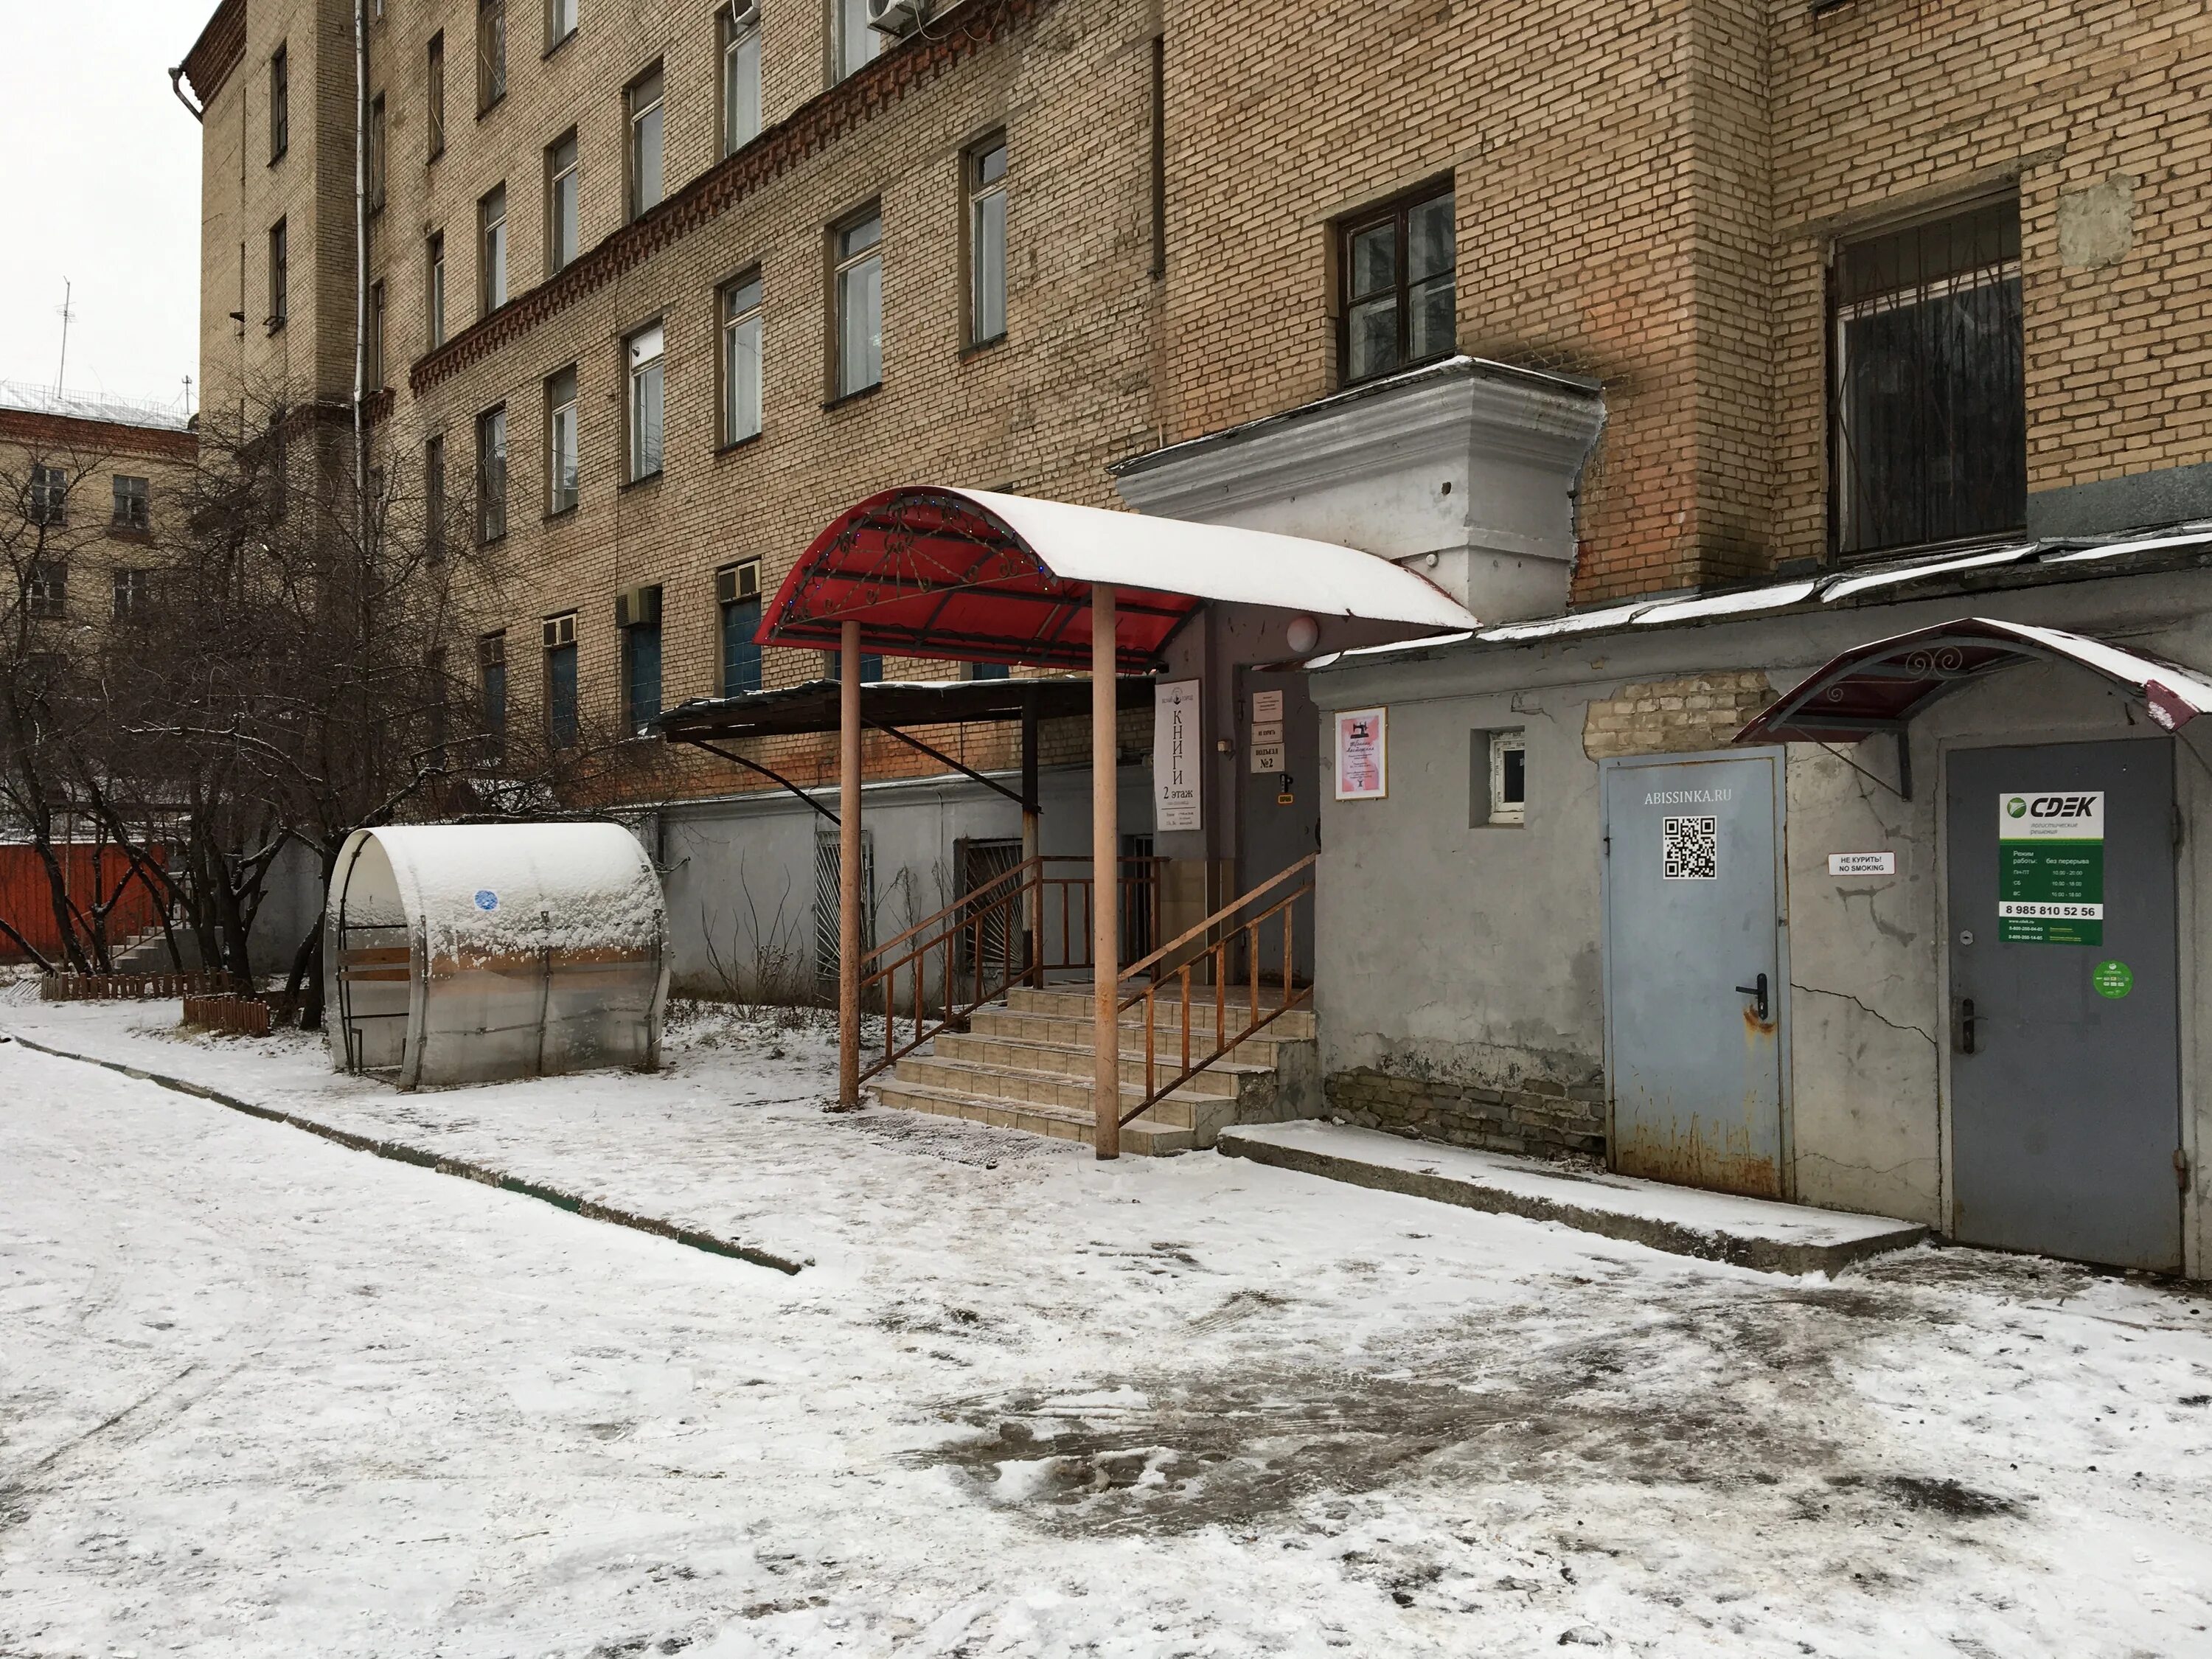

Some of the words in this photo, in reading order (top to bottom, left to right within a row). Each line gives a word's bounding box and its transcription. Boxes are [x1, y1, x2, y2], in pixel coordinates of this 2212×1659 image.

[1173, 710, 1183, 785] КНИГИ
[1256, 748, 1279, 756] ПОДЪЕЗД
[1260, 758, 1273, 768] №2
[1164, 786, 1169, 799] 2
[1172, 790, 1193, 799] этаж
[1644, 789, 1732, 804] ABISSINKA.RU
[2031, 796, 2098, 817] CDEK
[2006, 905, 2012, 914] 8
[2016, 905, 2036, 914] 985
[2039, 906, 2060, 915] 810
[2064, 907, 2077, 916] 52
[2081, 907, 2096, 916] 56
